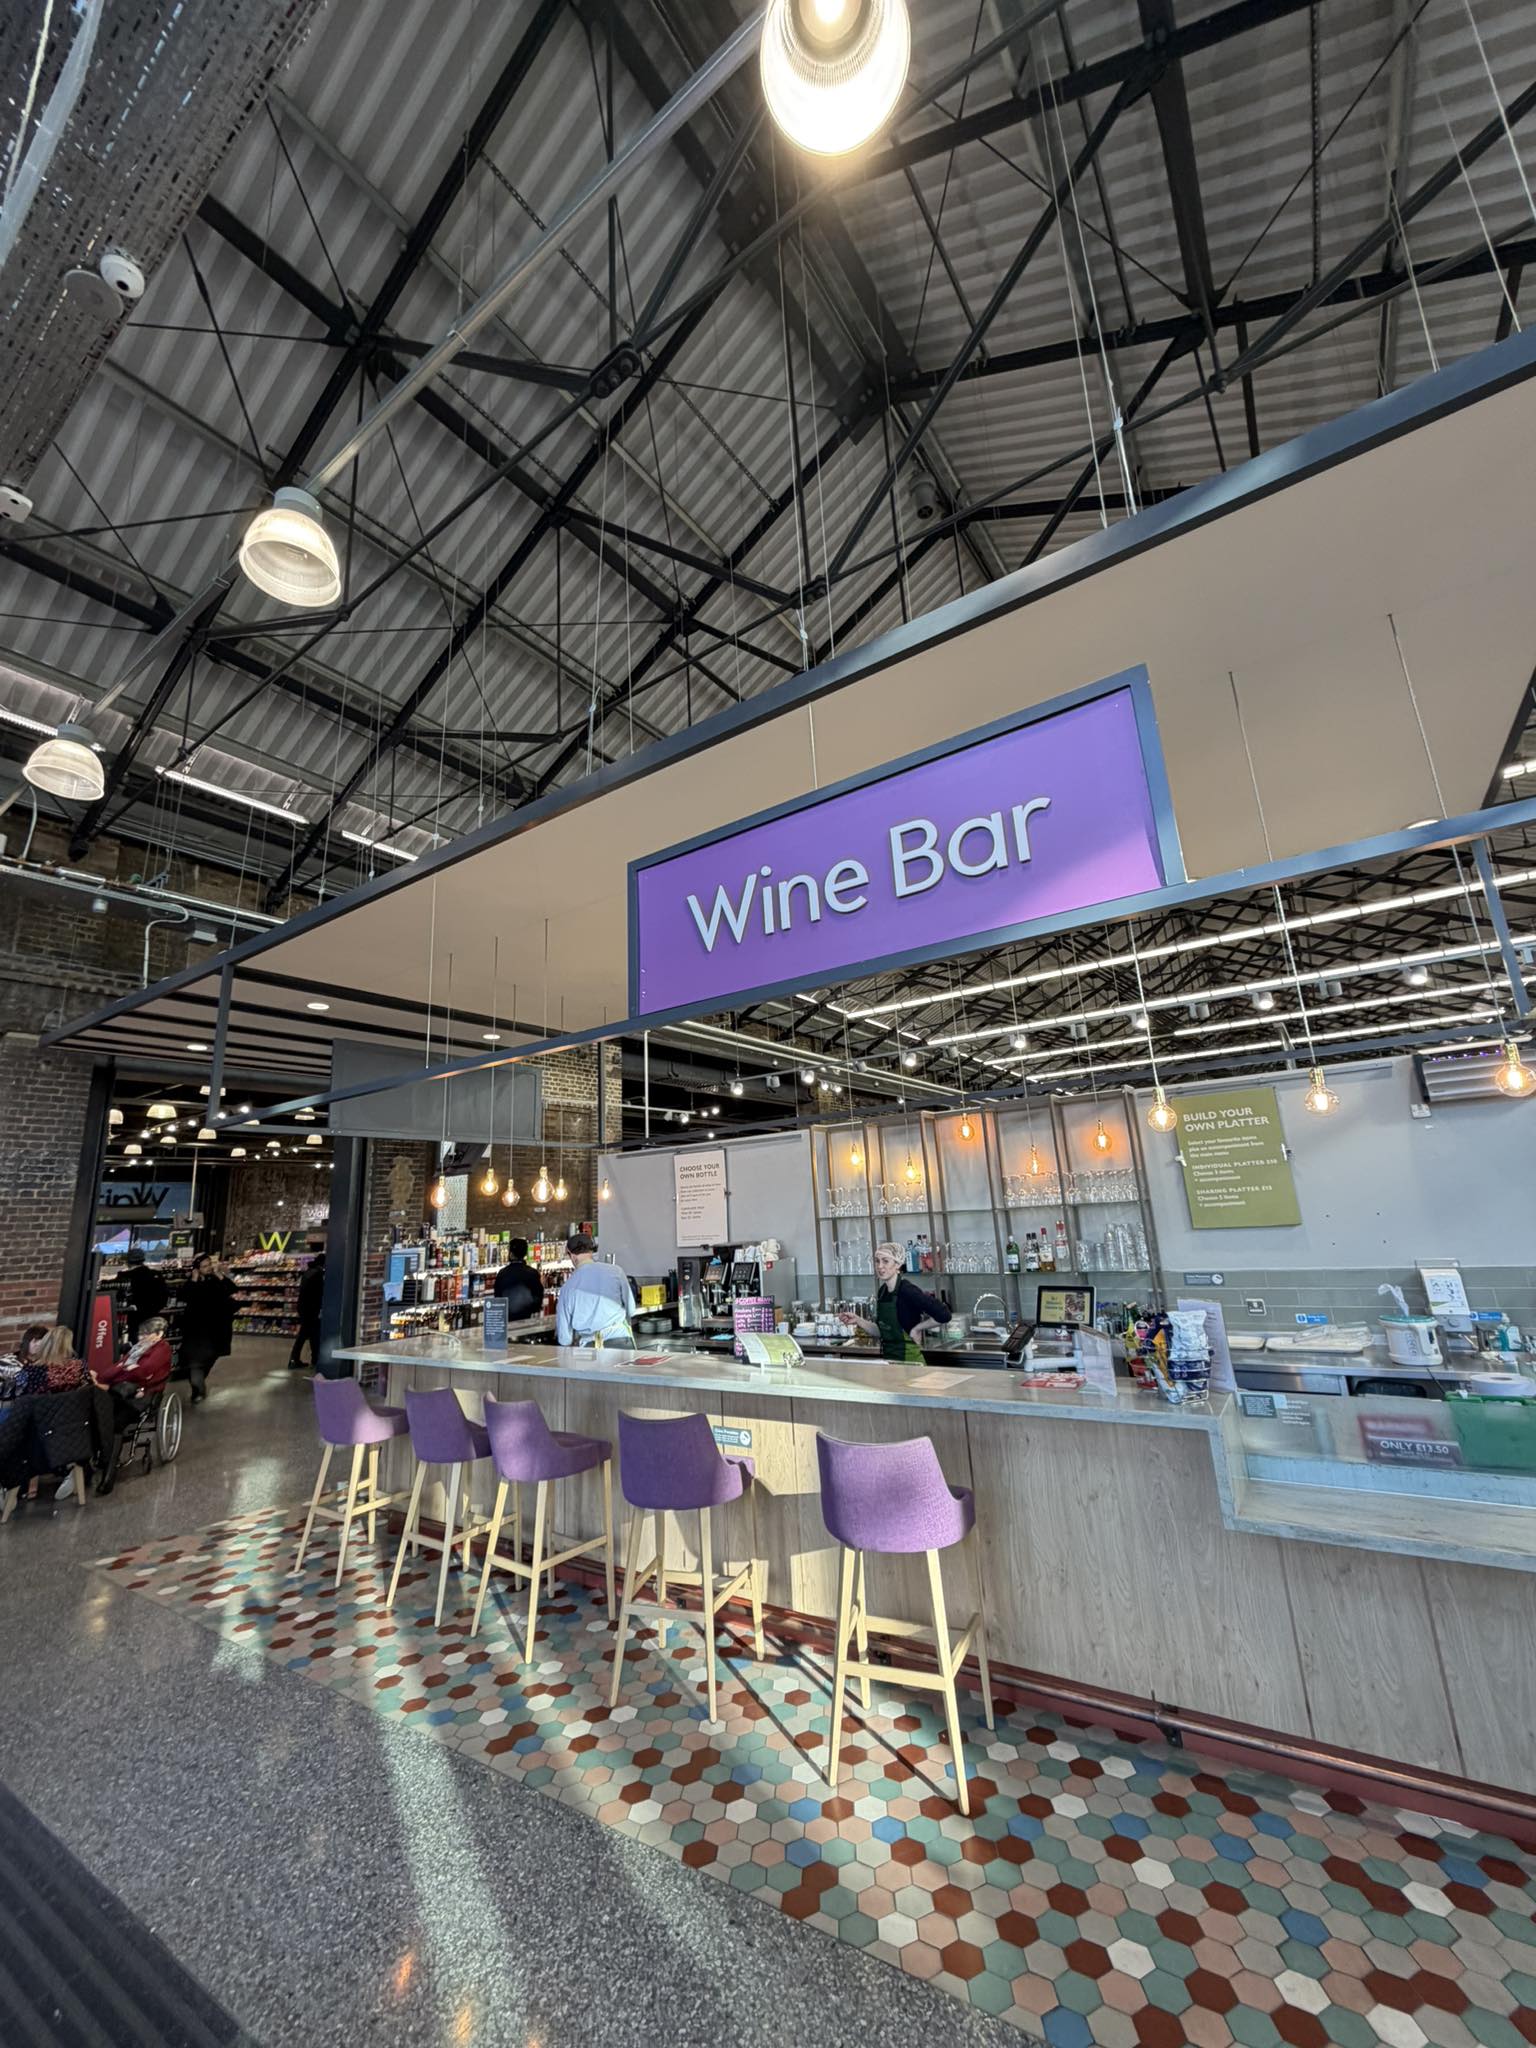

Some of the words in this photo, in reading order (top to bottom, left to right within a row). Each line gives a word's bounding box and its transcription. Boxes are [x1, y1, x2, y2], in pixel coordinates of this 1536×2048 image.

[686, 859, 869, 952] Wine
[888, 797, 1051, 898] Bar
[1183, 1111, 1217, 1122] BUILD
[1219, 1107, 1254, 1117] YOUR
[1185, 1122, 1216, 1132] OWN
[1218, 1116, 1270, 1129] PLATTER
[680, 1165, 702, 1173] CHOOSE
[696, 1170, 718, 1178] BOTTLE
[95, 1320, 108, 1349] Offers
[1380, 1440, 1413, 1451] ONLY
